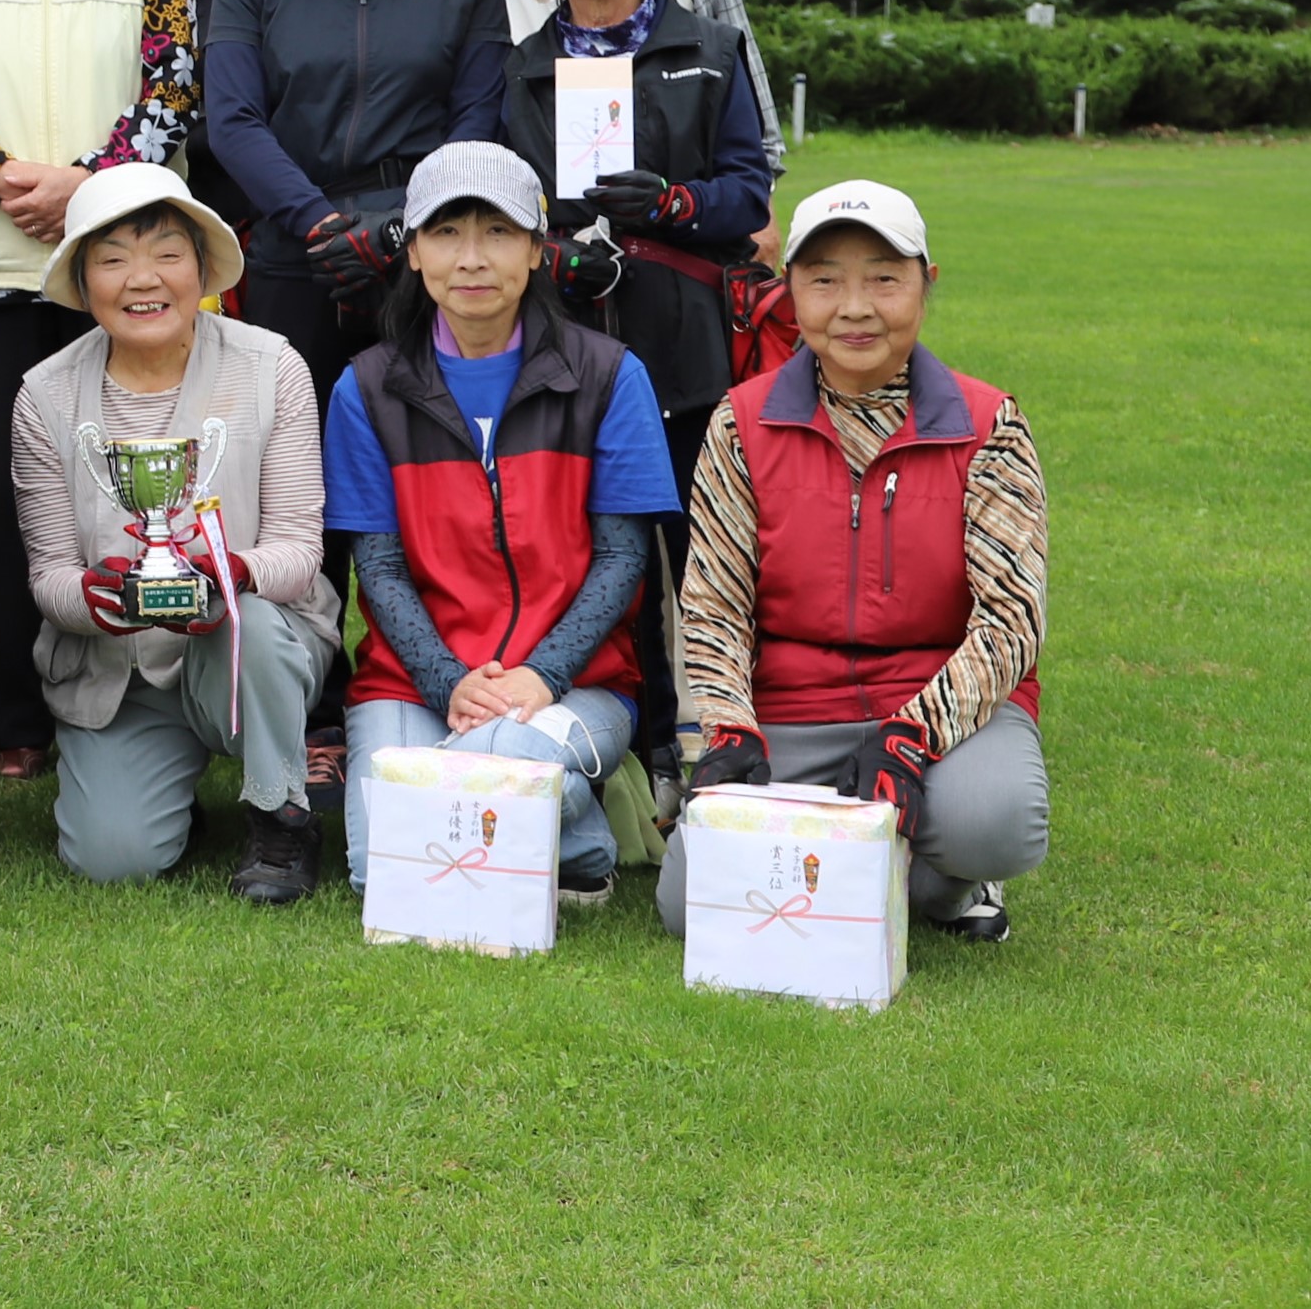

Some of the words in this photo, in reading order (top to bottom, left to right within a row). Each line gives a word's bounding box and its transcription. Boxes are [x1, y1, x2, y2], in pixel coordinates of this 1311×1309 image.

[828, 199, 871, 213] FILA
[448, 800, 463, 843] 準優勝
[769, 844, 784, 890] 賞三位
[792, 845, 802, 884] 女子の部
